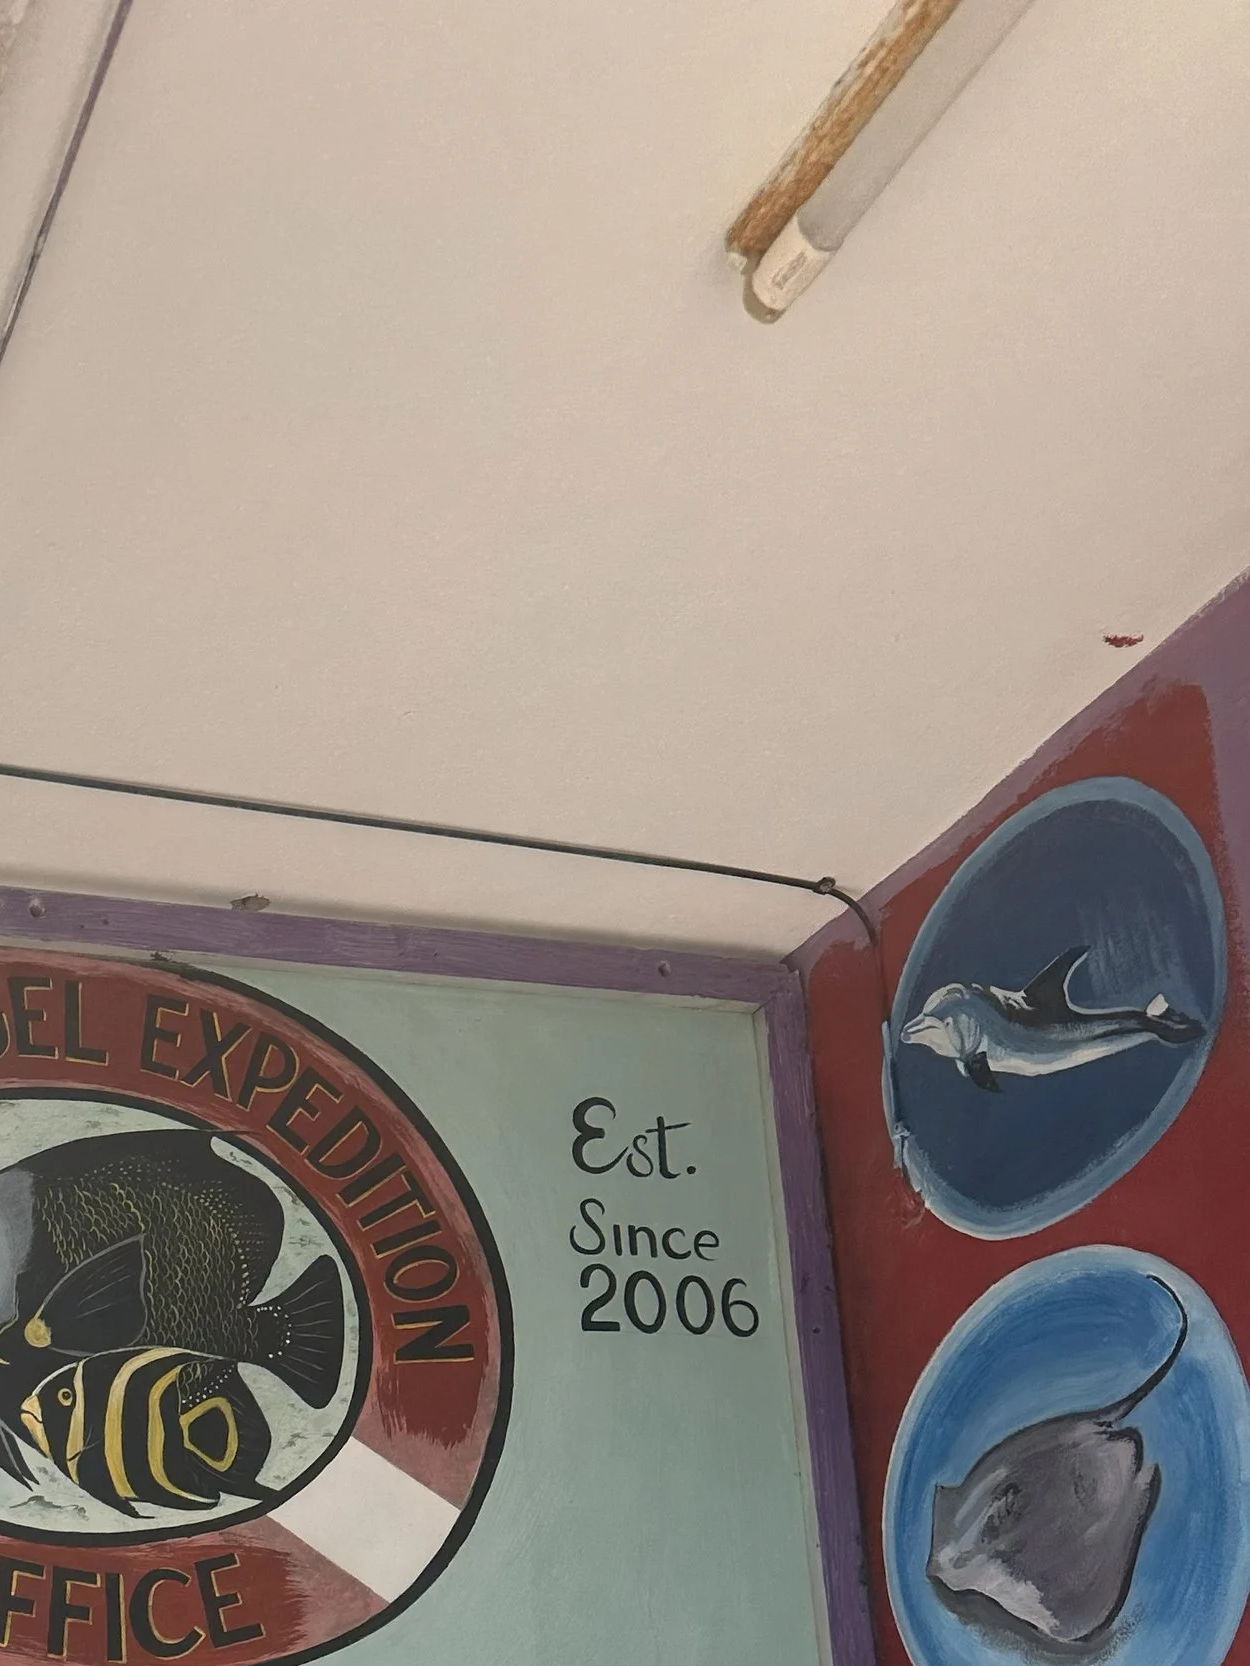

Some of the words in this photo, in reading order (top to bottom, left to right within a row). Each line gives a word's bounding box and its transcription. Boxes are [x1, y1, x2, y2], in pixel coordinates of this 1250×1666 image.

[571, 1097, 697, 1179] Est.
[140, 998, 476, 1365] EXPEDITION
[569, 1198, 720, 1261] Since
[579, 1263, 760, 1338] 2006
